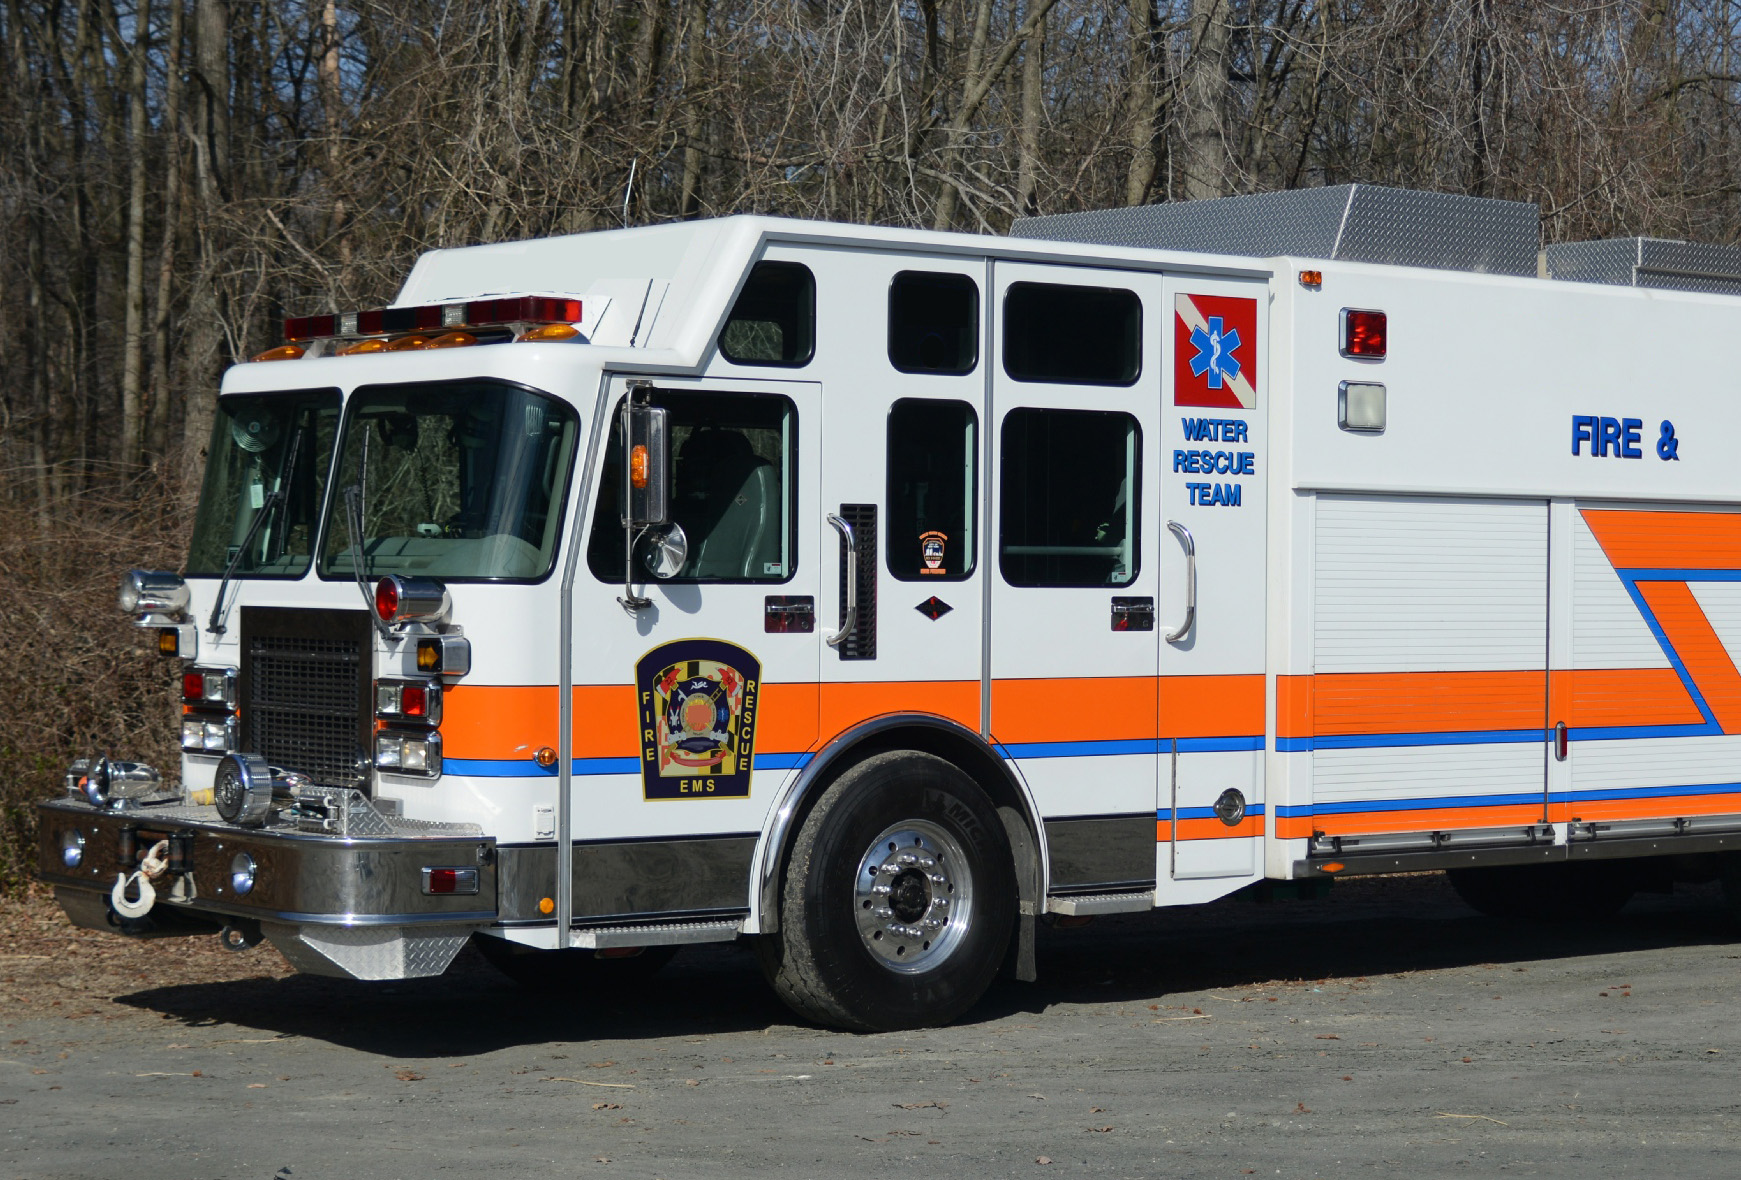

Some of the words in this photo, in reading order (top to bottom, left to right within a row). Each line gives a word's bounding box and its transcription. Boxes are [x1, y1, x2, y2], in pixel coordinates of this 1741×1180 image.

[1181, 417, 1248, 443] WATER
[1571, 414, 1643, 460] FIRE
[1656, 419, 1680, 461] &
[1173, 449, 1255, 475] RESCUE
[1185, 482, 1242, 507] TEAM
[642, 691, 655, 761] FIRE
[739, 680, 756, 771] RESCUE
[680, 779, 715, 793] EMS
